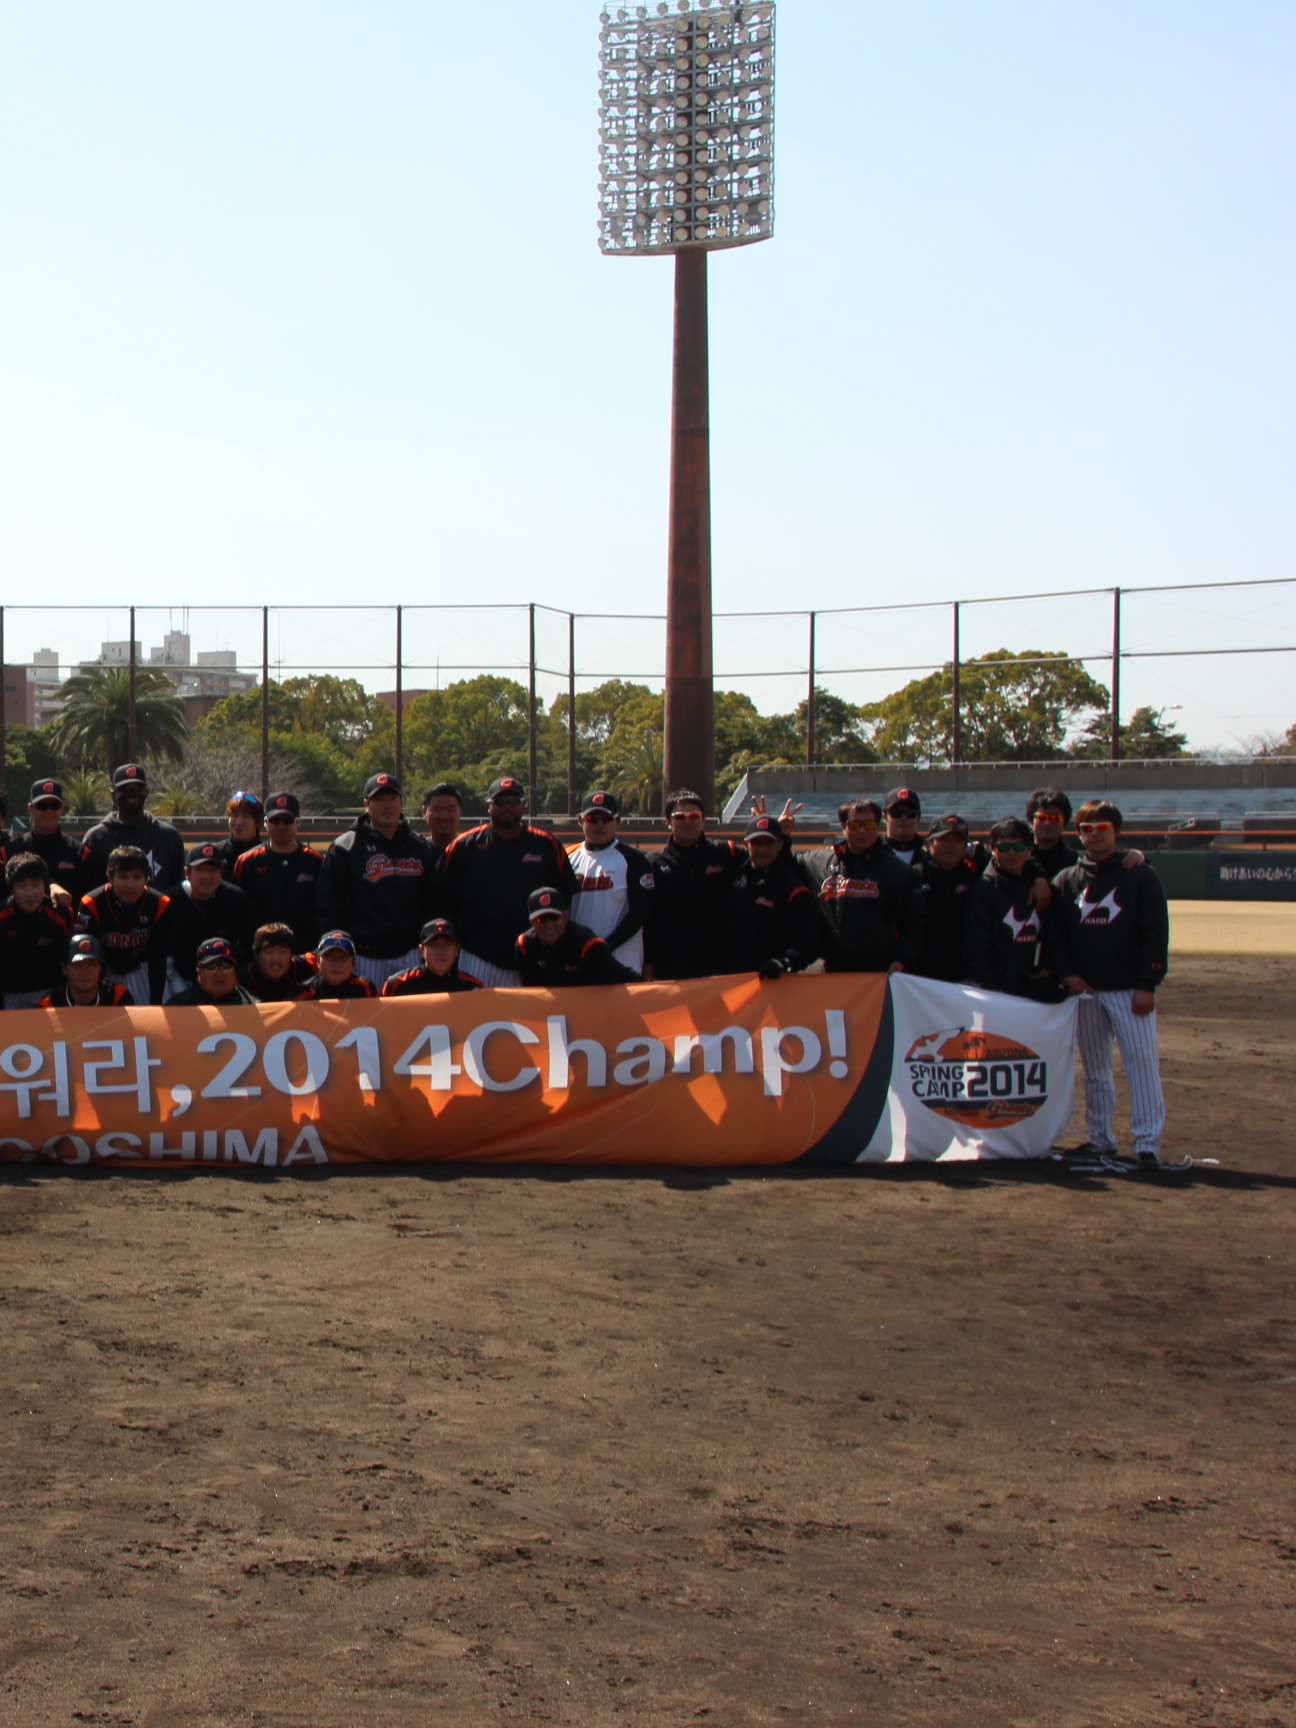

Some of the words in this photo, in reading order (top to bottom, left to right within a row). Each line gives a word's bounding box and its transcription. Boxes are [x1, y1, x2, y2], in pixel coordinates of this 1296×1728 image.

[363, 853, 425, 883] Giants
[1220, 866, 1296, 880] 助けあいの心から
[986, 1047, 1030, 1059] ARIZONA
[966, 1061, 1047, 1097] 2014
